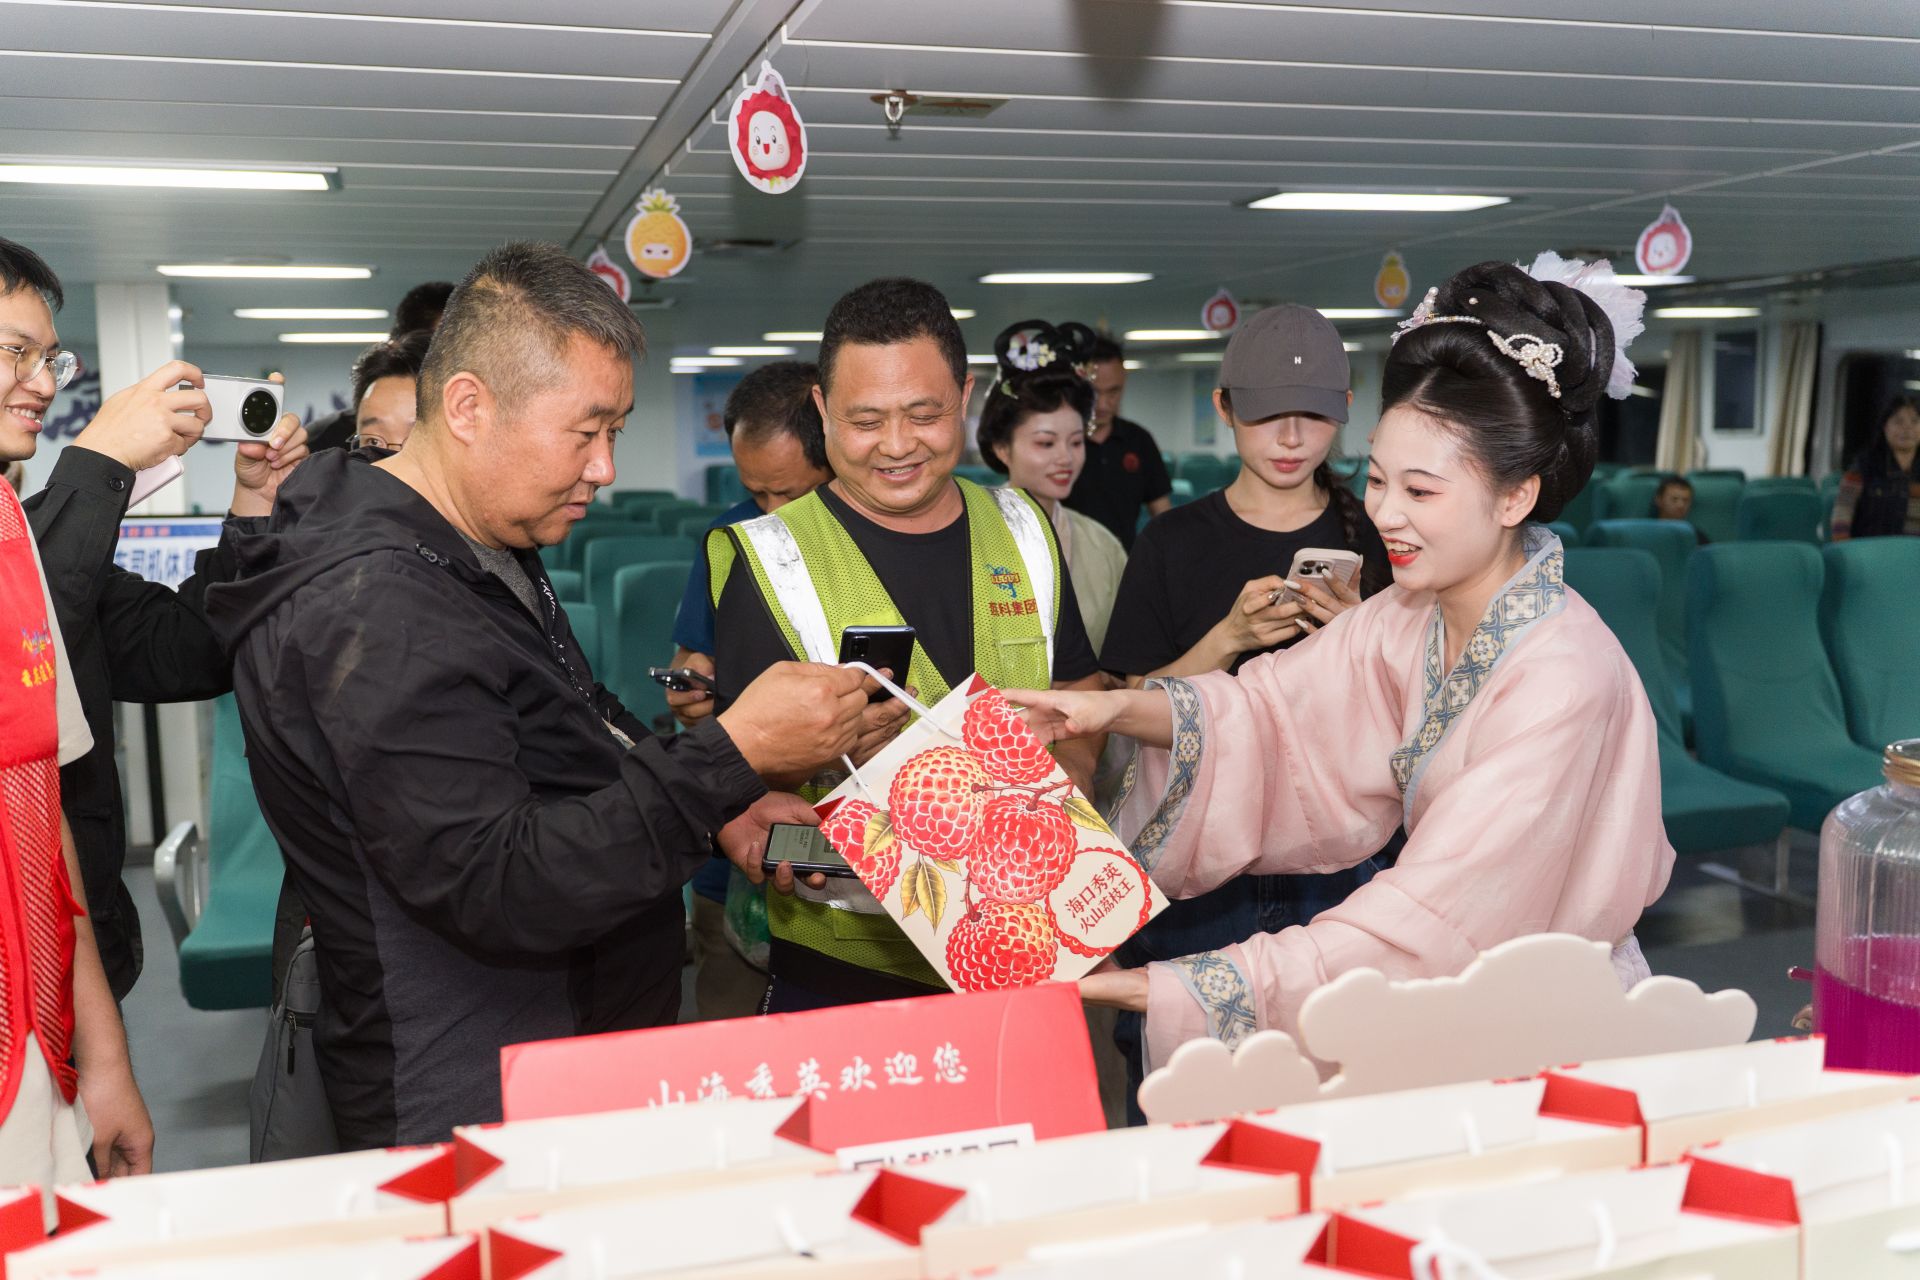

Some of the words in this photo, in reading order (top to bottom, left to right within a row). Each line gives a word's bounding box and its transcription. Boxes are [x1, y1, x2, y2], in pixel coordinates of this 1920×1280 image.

[1294, 356, 1302, 364] H
[1064, 861, 1122, 919] 海口秀英
[1080, 877, 1136, 935] 火山荔枝王
